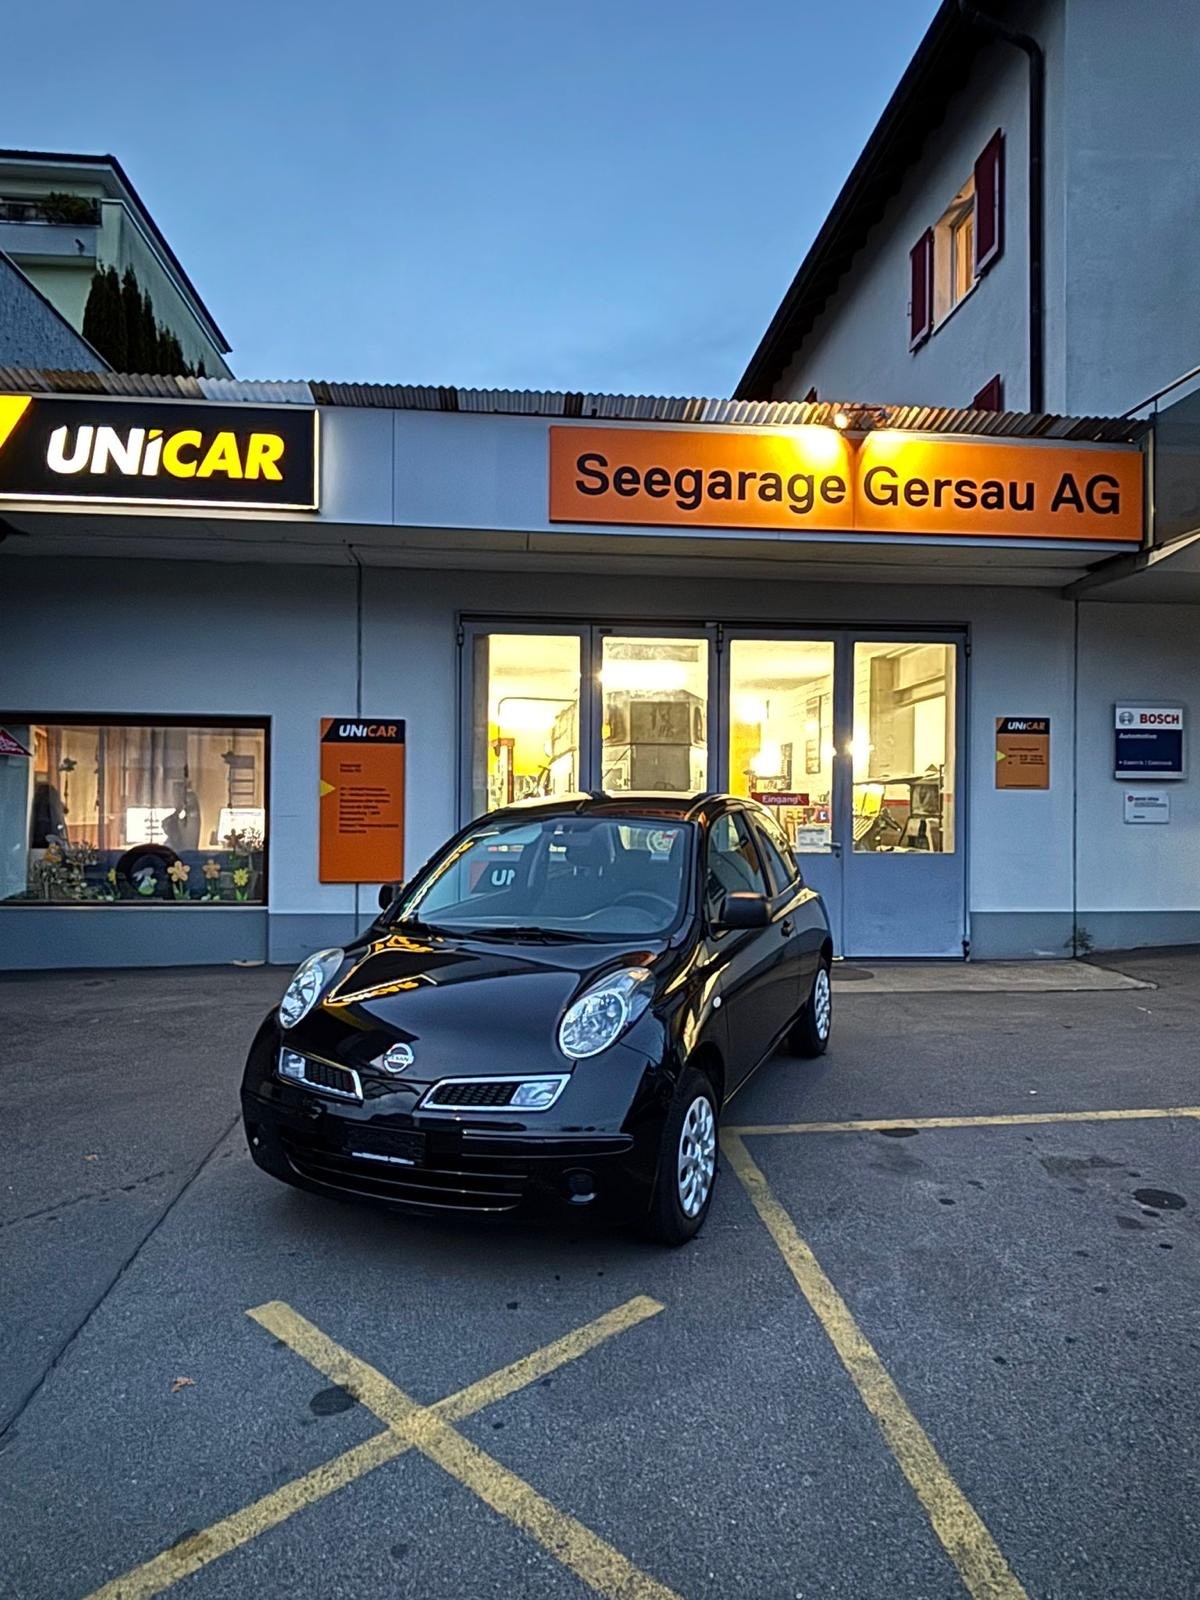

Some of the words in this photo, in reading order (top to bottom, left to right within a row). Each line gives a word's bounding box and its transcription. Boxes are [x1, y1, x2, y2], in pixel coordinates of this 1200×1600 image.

[575, 452, 847, 514] Seegarage
[863, 465, 1035, 511] Gersau
[1051, 473, 1120, 514] AG
[1139, 713, 1179, 724] BOSCH
[762, 795, 798, 805] Eingang
